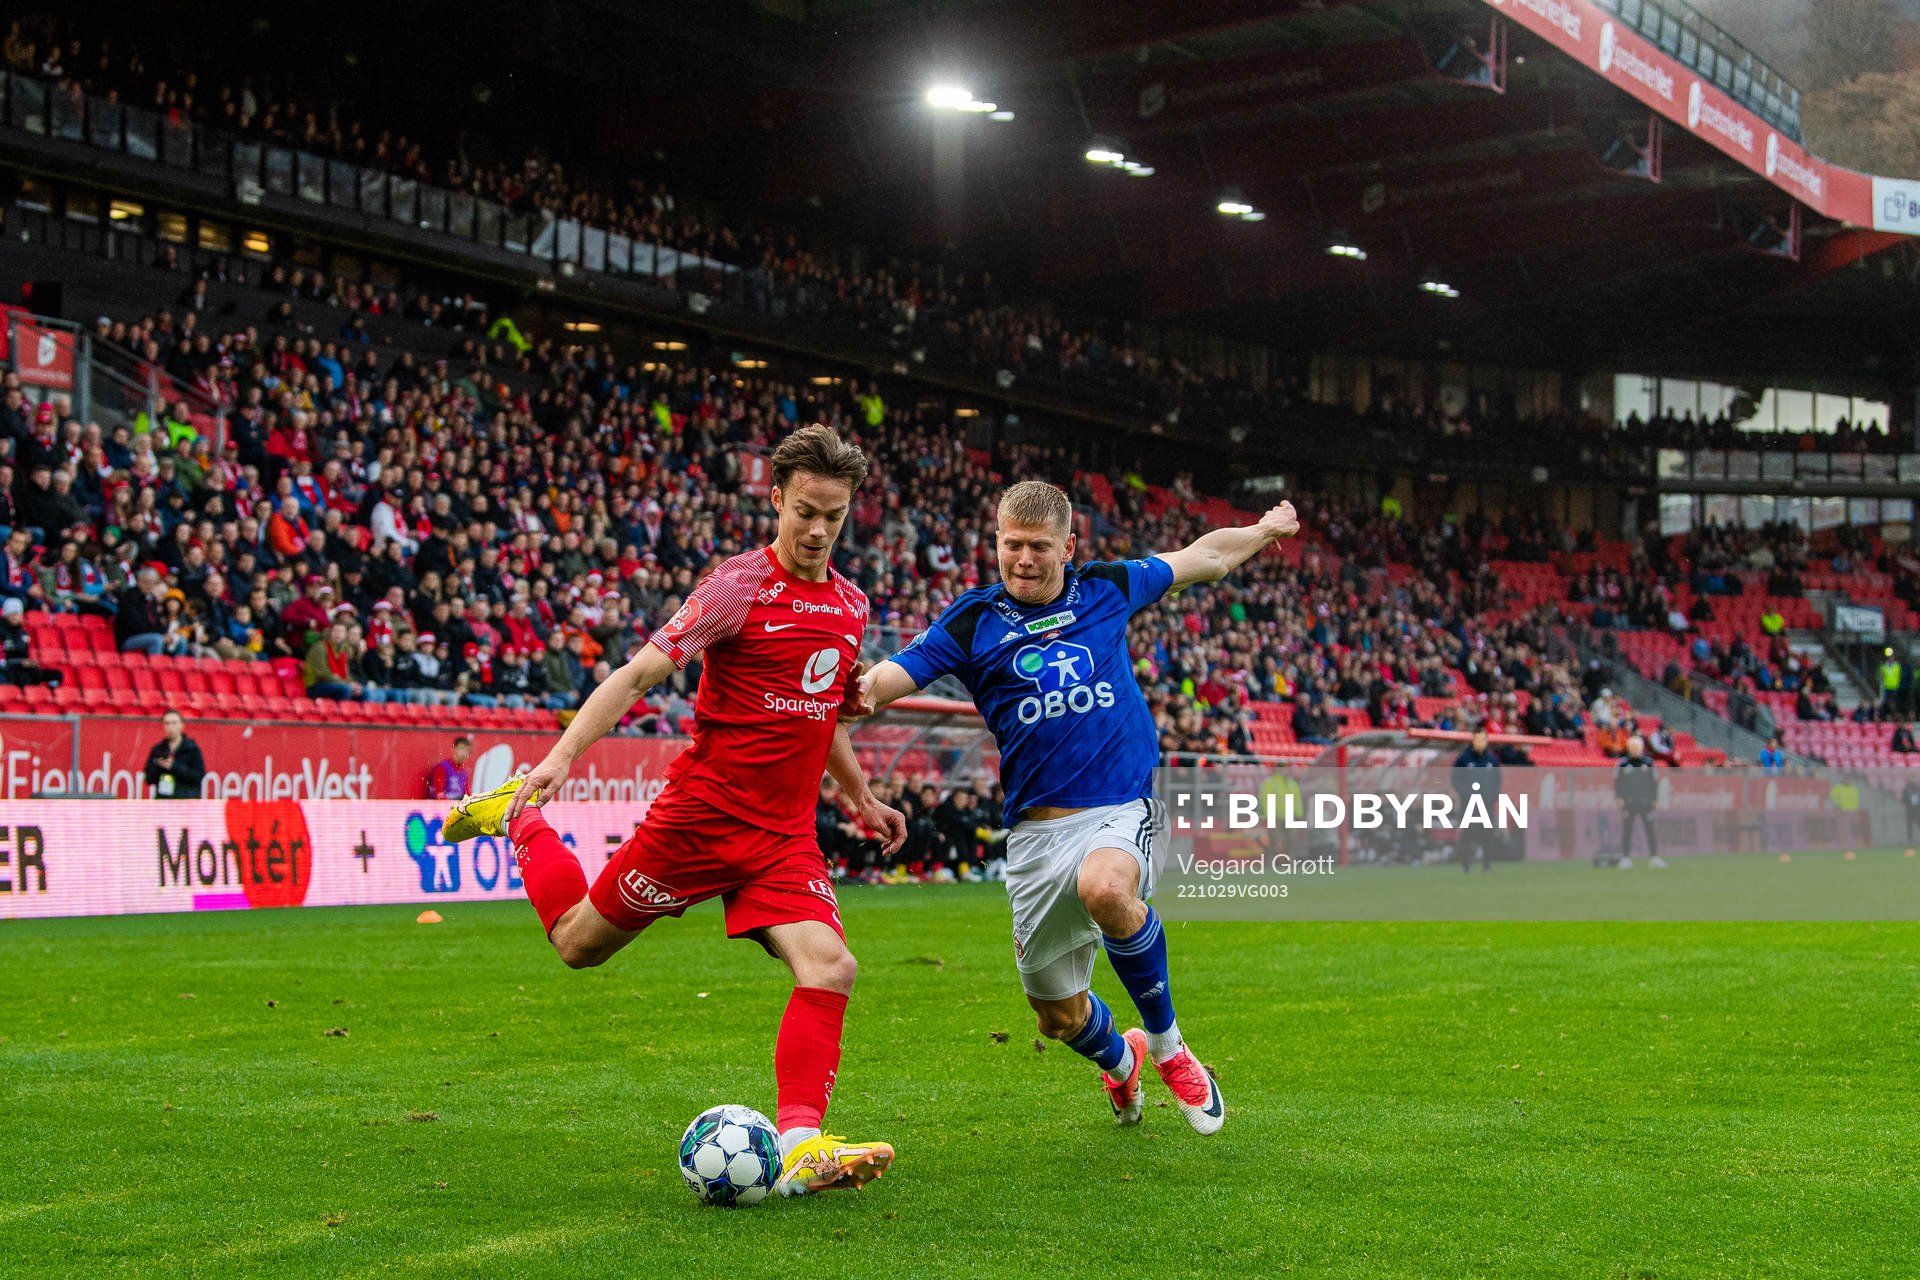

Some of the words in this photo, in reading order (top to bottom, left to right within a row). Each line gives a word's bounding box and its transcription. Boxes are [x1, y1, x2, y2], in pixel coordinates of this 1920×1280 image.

[998, 601, 1024, 622] enjoy
[1017, 681, 1115, 725] OBOS
[157, 819, 304, 887] Montér
[624, 868, 677, 904] LERØ
